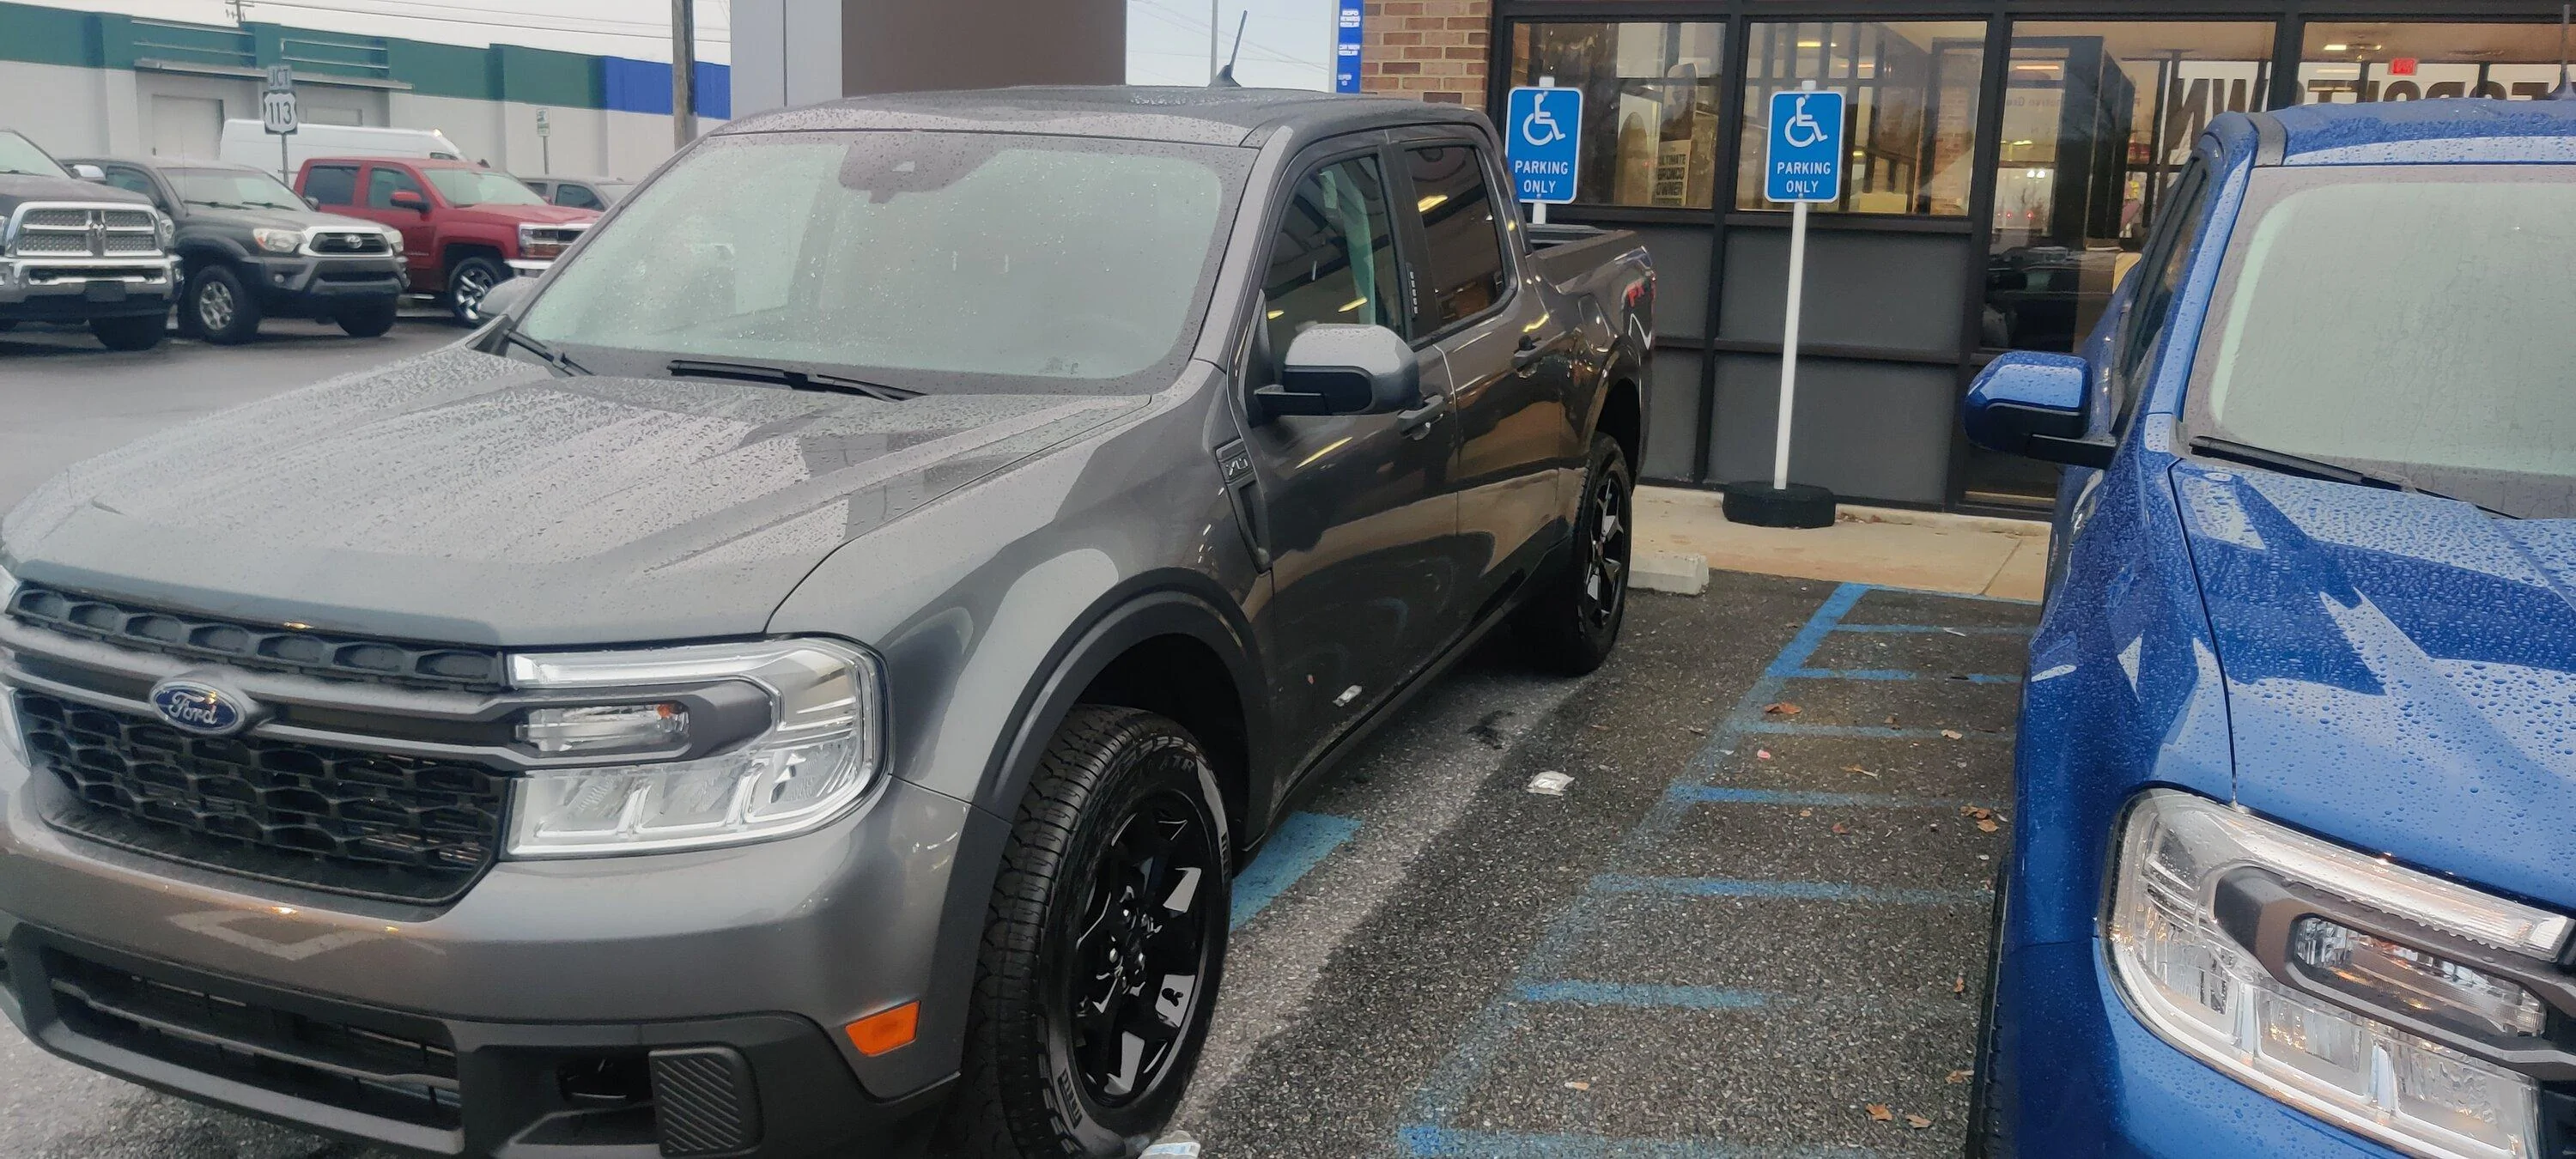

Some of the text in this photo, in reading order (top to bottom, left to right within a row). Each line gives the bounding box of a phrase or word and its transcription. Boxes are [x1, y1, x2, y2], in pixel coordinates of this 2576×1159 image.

[270, 69, 290, 87] JCT
[269, 101, 293, 124] 113
[1515, 160, 1568, 175] PARKING
[1777, 161, 1831, 175] PARKING
[1523, 179, 1556, 194] ONLY
[1786, 179, 1819, 193] ONLY
[170, 690, 218, 725] Ford
